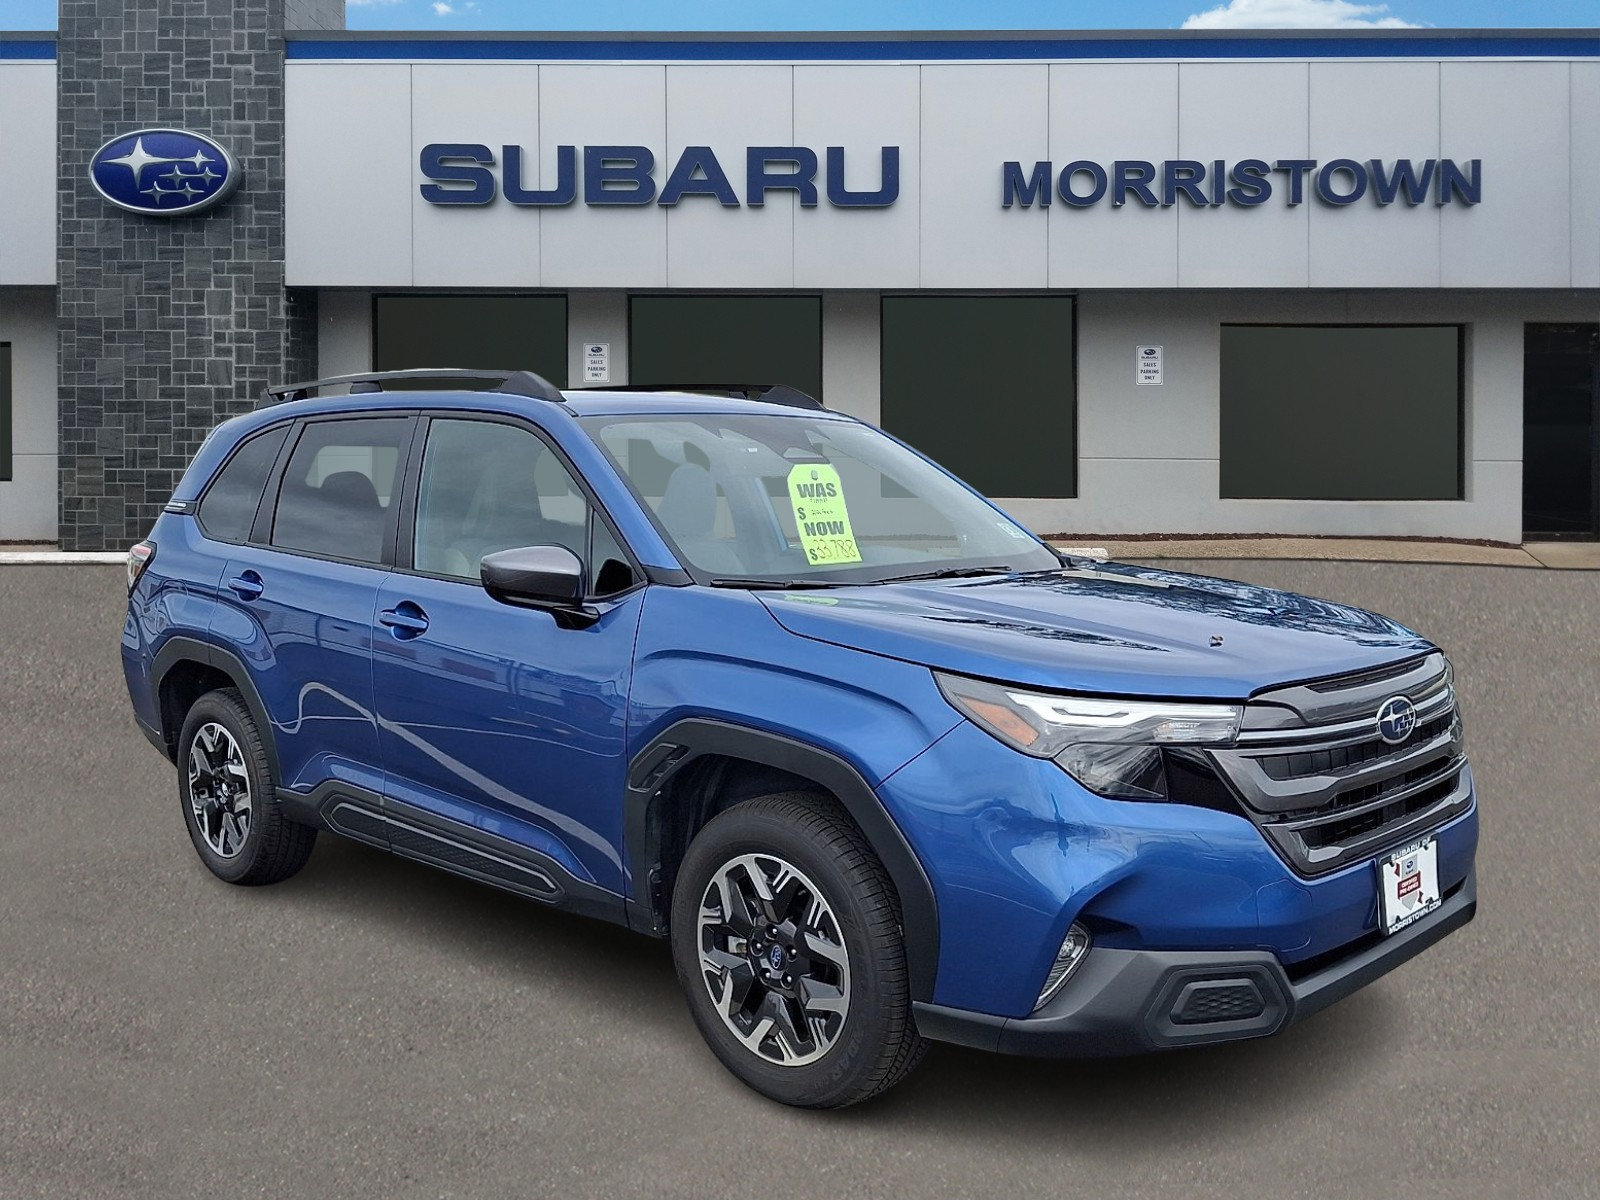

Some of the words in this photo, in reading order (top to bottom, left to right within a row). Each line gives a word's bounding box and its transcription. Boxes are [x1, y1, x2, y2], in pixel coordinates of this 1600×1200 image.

[419, 143, 900, 207] SUBARU
[1002, 158, 1482, 208] MORRISTOWN
[796, 482, 837, 498] WAS
[804, 520, 845, 537] NOW
[1391, 842, 1421, 862] SUBARU
[1388, 898, 1442, 935] MORRISTOWN.COM
